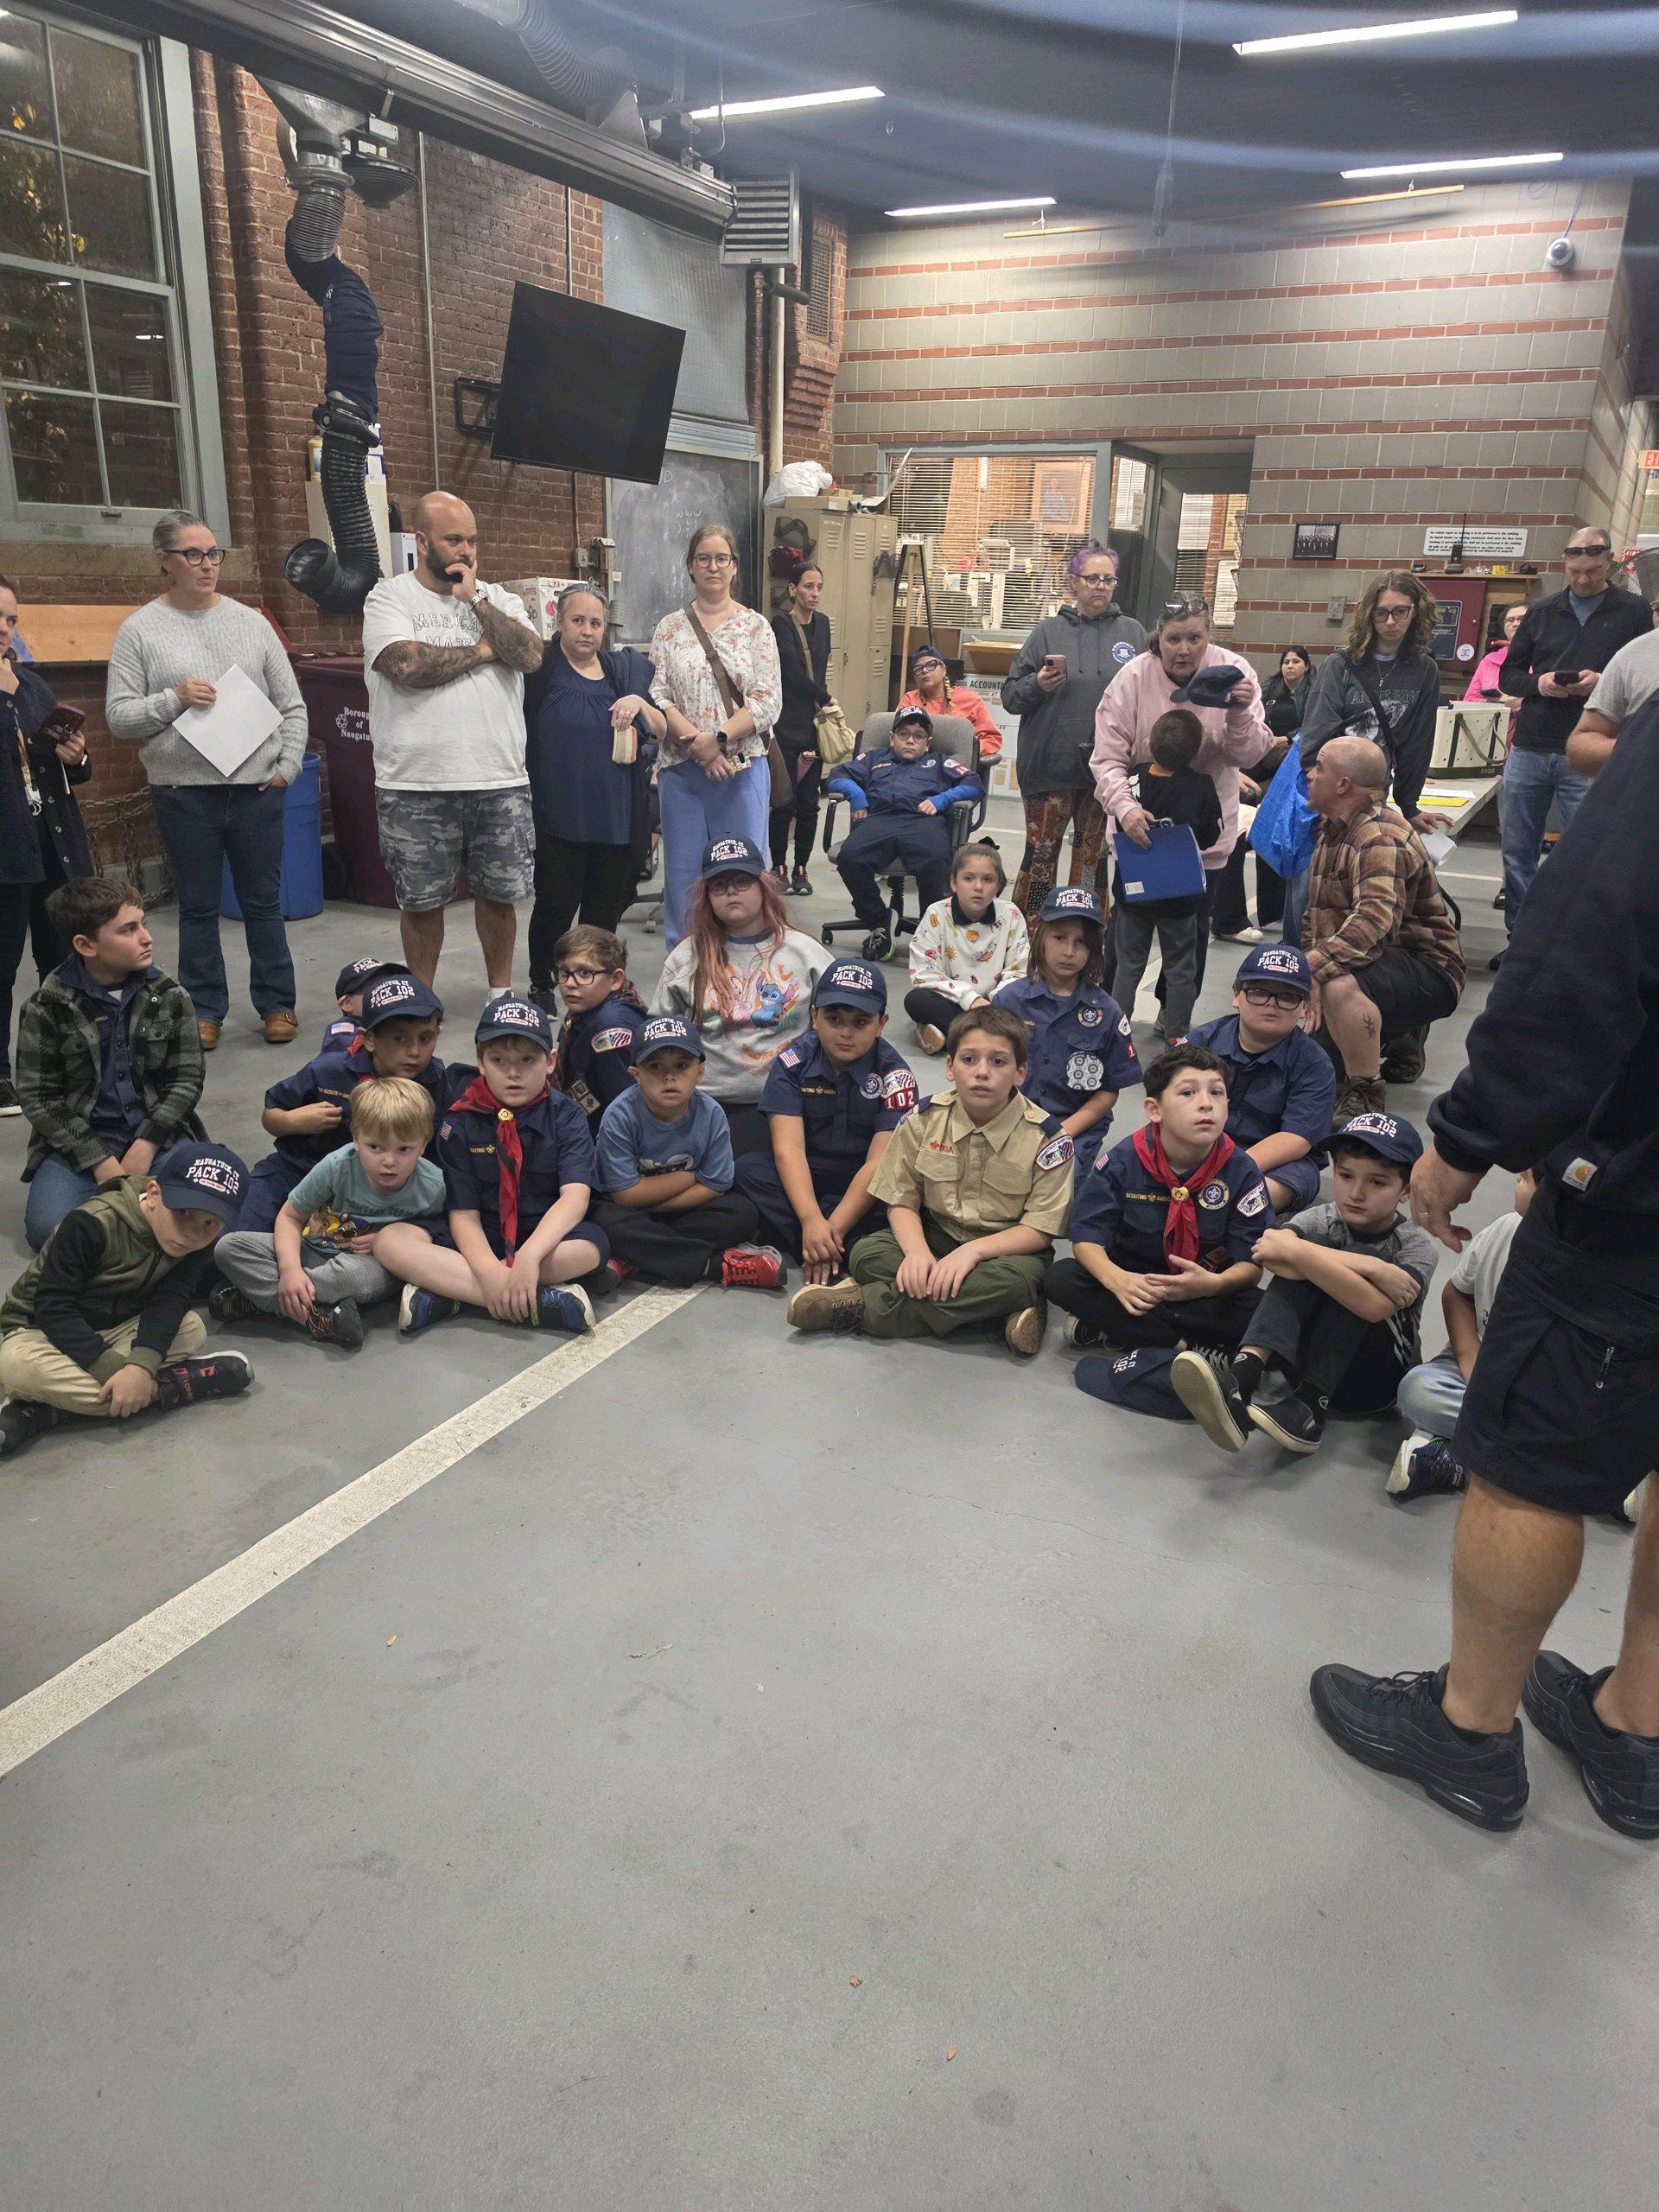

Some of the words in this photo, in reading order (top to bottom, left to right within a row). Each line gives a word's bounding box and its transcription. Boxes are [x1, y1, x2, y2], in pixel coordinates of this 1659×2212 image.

[356, 721, 363, 729] of
[341, 729, 370, 741] Naugatu
[711, 845, 731, 861] PACK
[734, 845, 748, 856] 102
[1055, 893, 1078, 907] PACK
[1081, 895, 1094, 909] 102
[354, 958, 375, 974] PACK
[1257, 955, 1283, 966] PACK
[1285, 958, 1299, 973] 102
[831, 971, 855, 982] PACK
[858, 974, 873, 989] 102
[370, 986, 393, 1008] PACK
[396, 985, 415, 996] 102
[493, 1009, 521, 1022] PACK
[524, 1011, 540, 1027] 102
[644, 1023, 667, 1041] PACK
[671, 1023, 687, 1036] 102
[887, 1090, 915, 1109] 102
[1376, 1120, 1397, 1138] 102
[940, 1144, 954, 1154] BSA
[185, 1166, 221, 1181] PACK
[223, 1174, 239, 1195] 102
